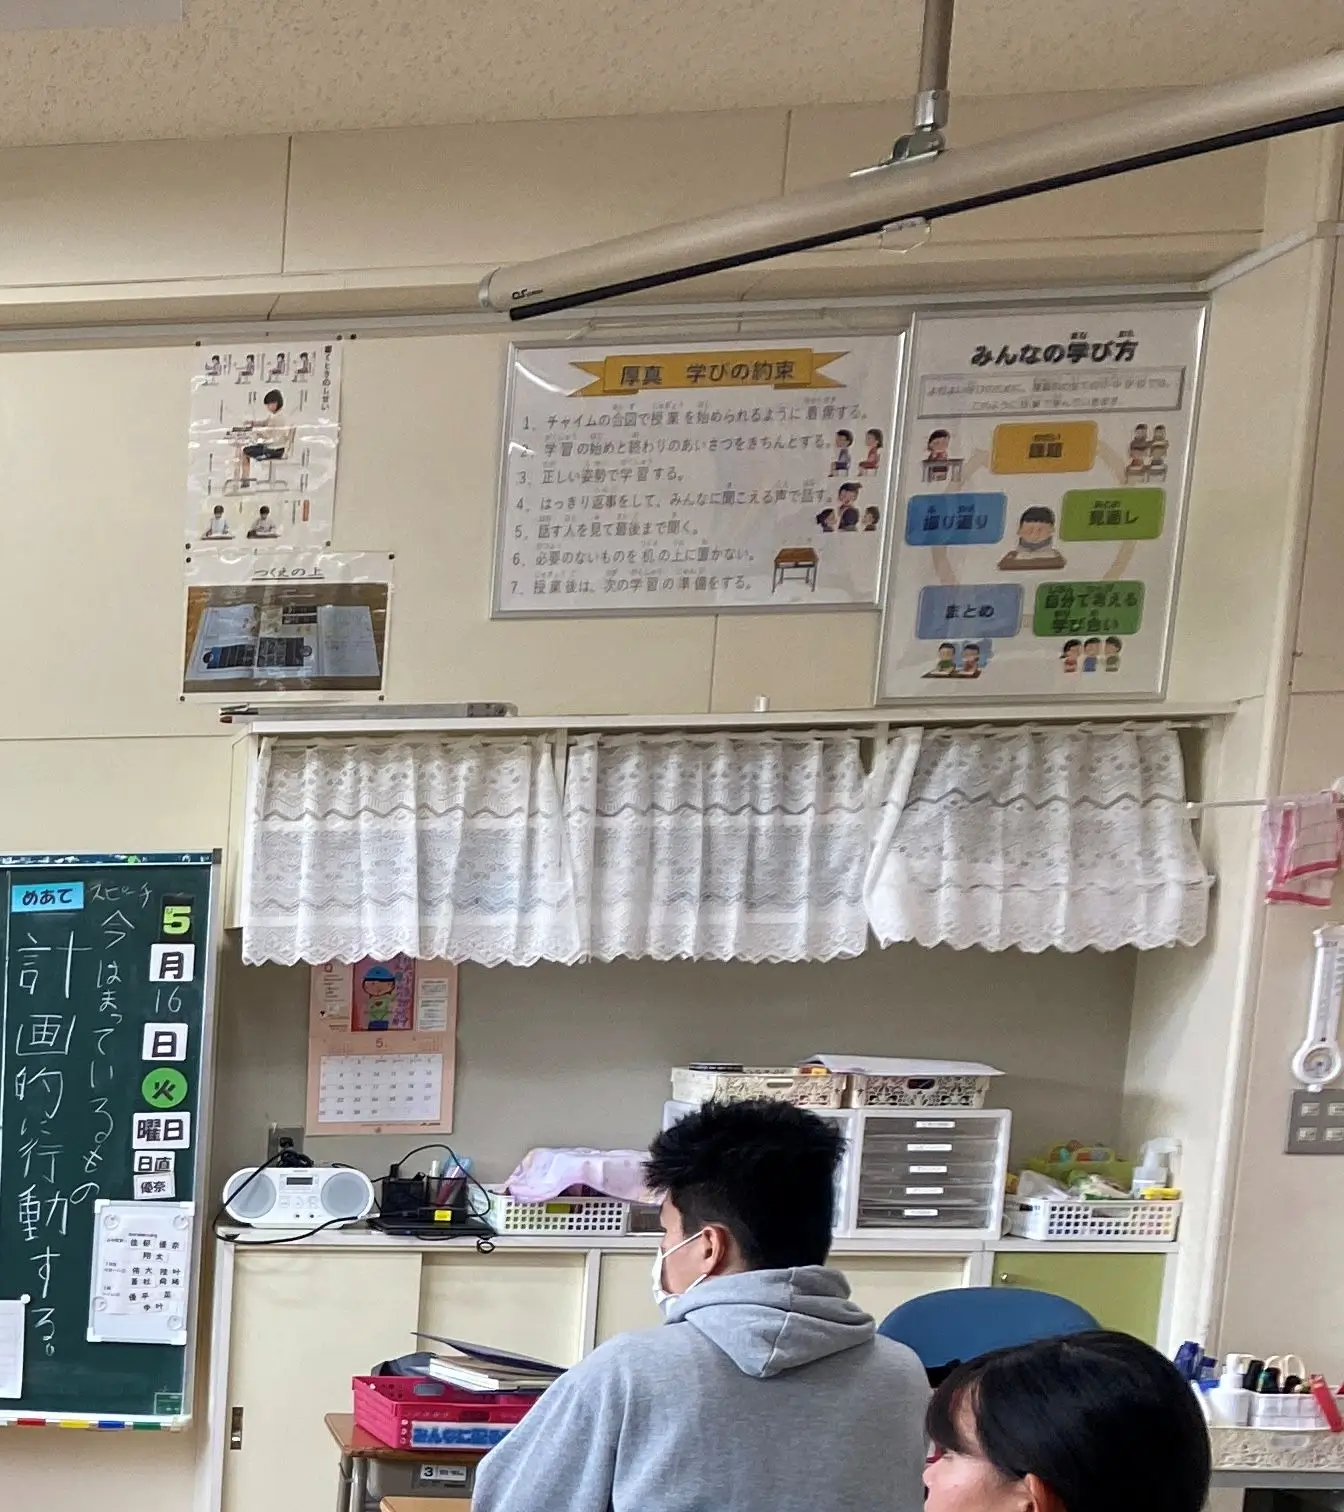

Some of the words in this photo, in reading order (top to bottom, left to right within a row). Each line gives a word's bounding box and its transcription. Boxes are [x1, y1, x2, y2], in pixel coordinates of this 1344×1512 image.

[970, 338, 1139, 368] みんなの学び方
[685, 359, 795, 384] 学びの約束
[944, 604, 995, 620] まとめ
[22, 887, 74, 906] めあて
[163, 905, 192, 935] 5
[158, 951, 184, 980] 月
[154, 985, 183, 1013] 16
[151, 1032, 179, 1057] 日
[152, 1077, 176, 1102] 火
[137, 1118, 184, 1142] 曜日
[138, 1155, 173, 1173] 日直
[423, 1466, 434, 1477] 3
